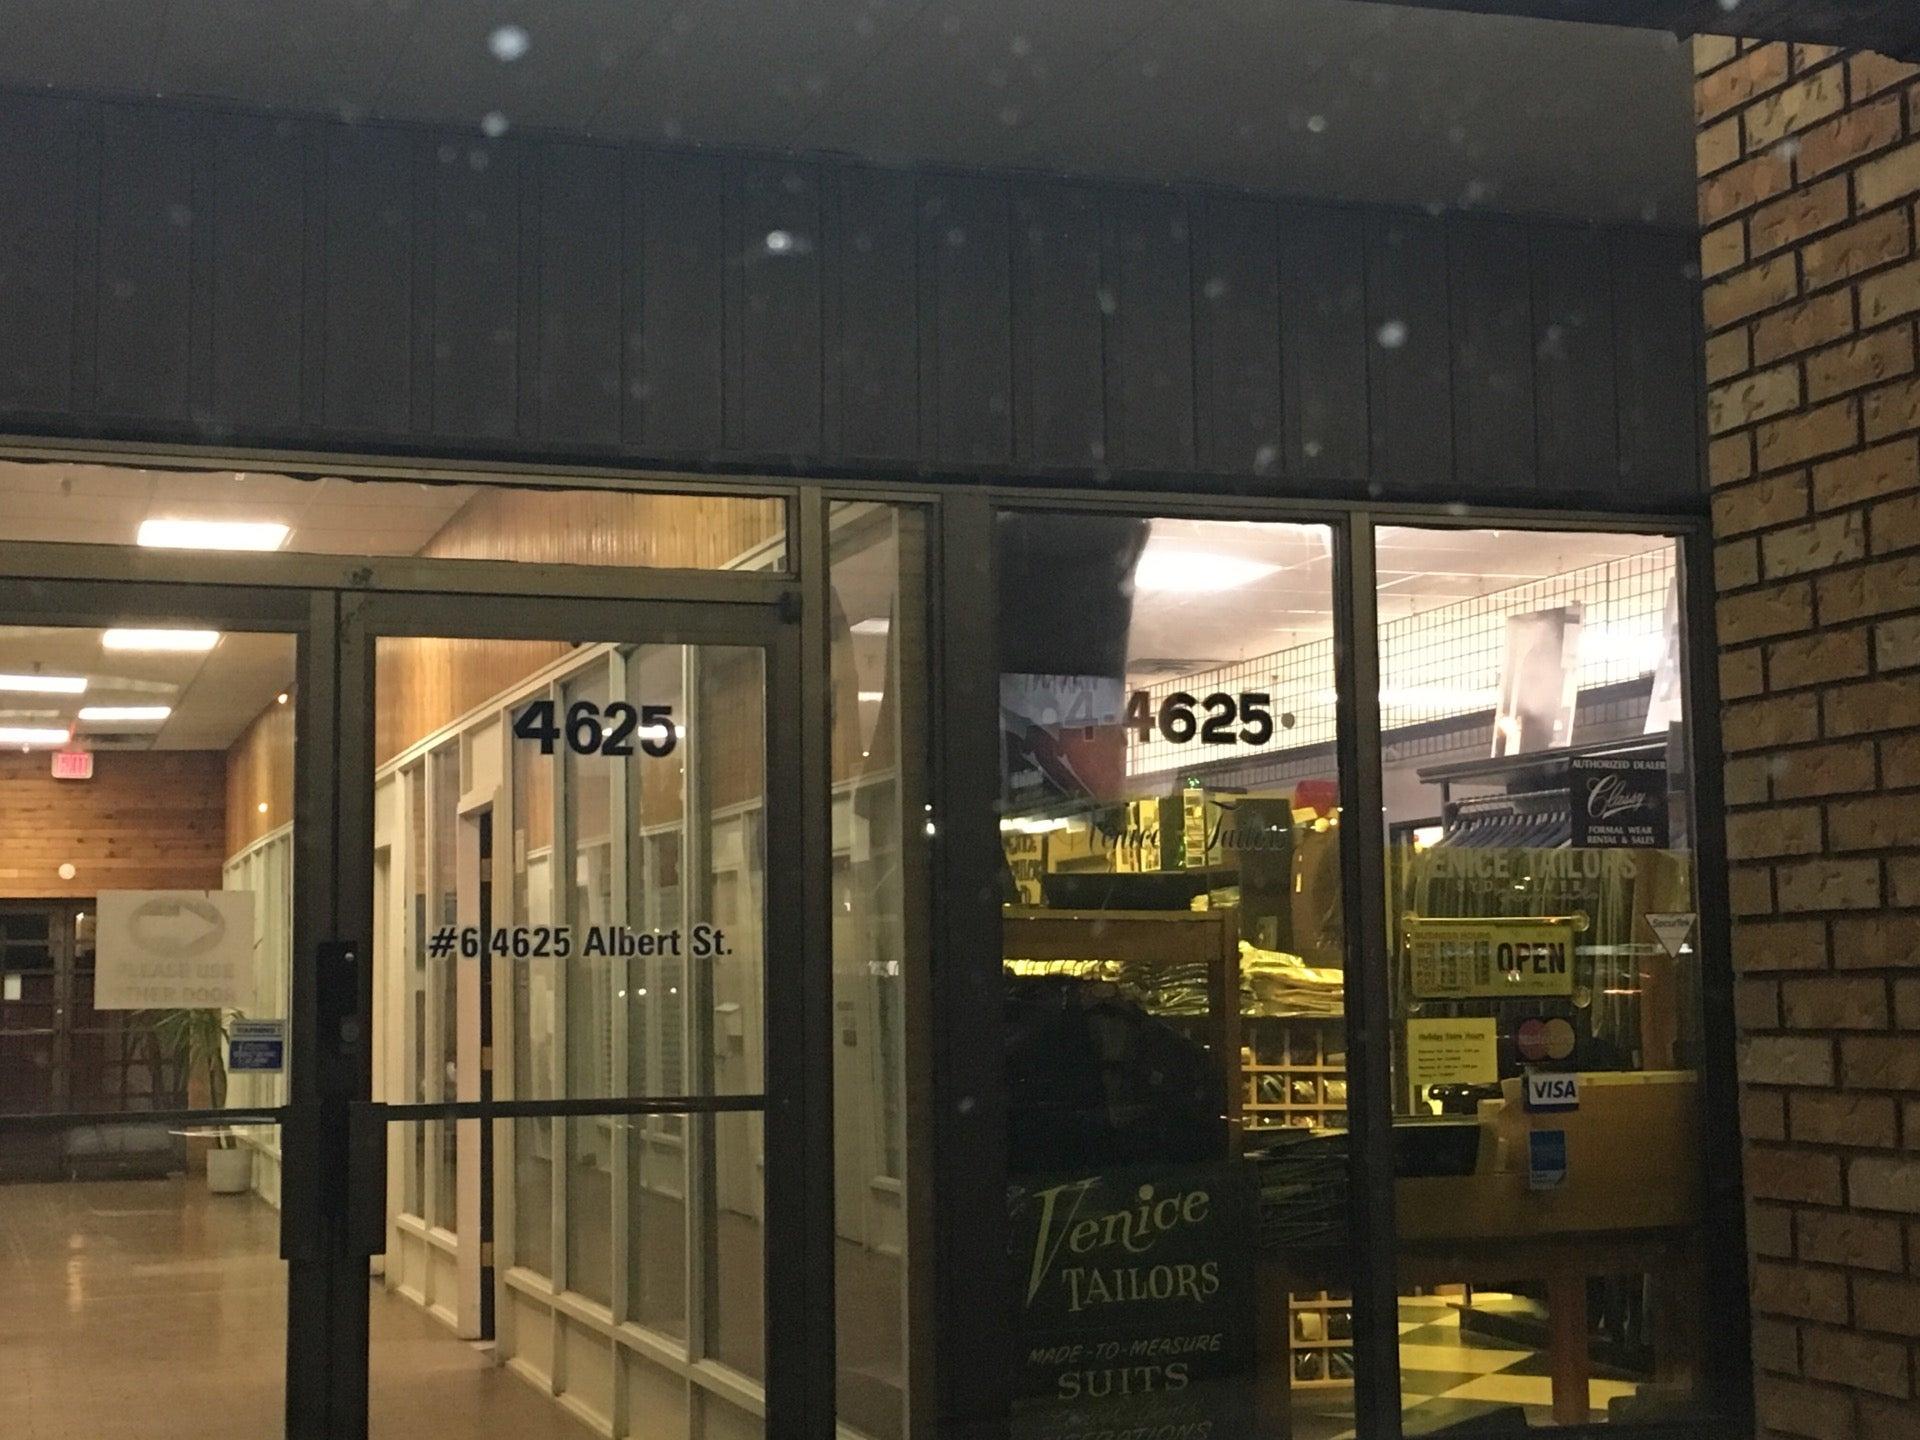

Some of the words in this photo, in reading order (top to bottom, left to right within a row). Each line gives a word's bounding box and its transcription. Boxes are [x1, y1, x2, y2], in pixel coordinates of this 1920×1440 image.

[513, 700, 678, 758] 4625
[1572, 759, 1630, 770] AUTHORIZED
[1633, 759, 1667, 770] DEALER
[1588, 826, 1624, 835] FORMAL
[1628, 825, 1653, 834] WEAR
[429, 926, 479, 959] #6
[491, 926, 571, 958] 4625
[583, 925, 681, 957] Albert
[692, 925, 733, 956] St.
[1497, 942, 1566, 974] OPEN
[1533, 1080, 1576, 1099] VISA
[1027, 1176, 1210, 1309] Venice
[1062, 1261, 1220, 1312] TAILORS
[1058, 1362, 1189, 1400] SUITS
